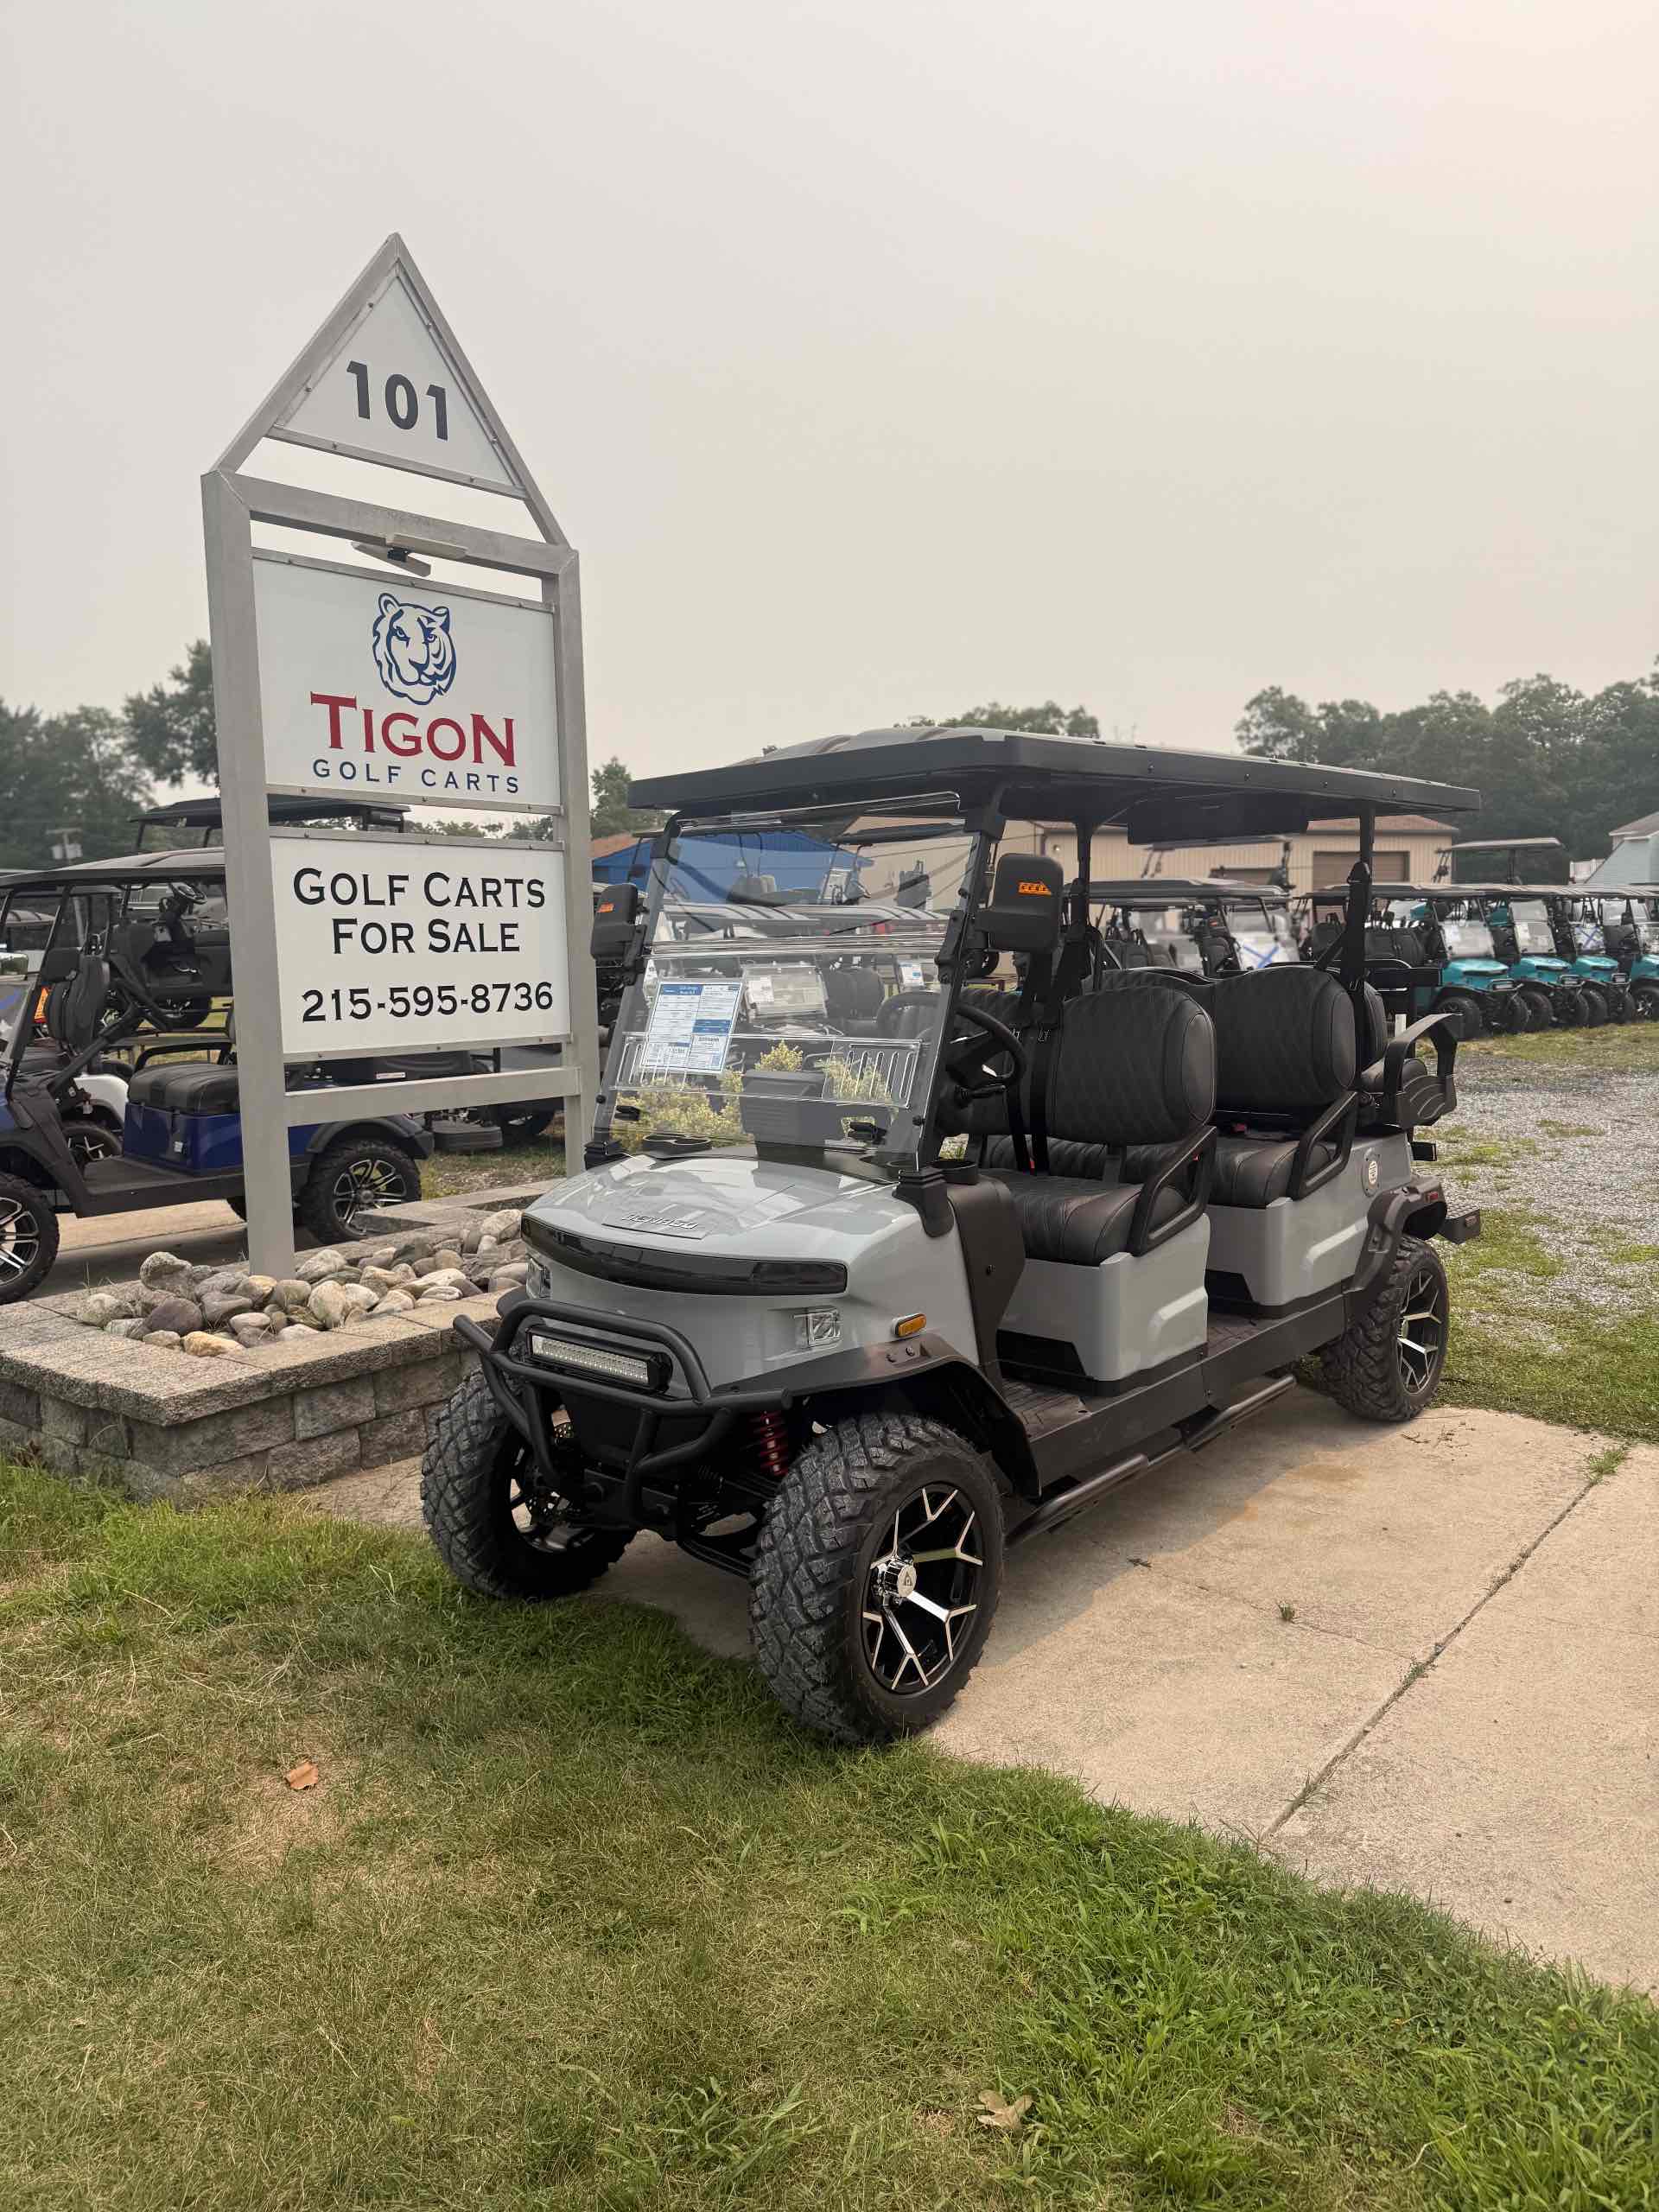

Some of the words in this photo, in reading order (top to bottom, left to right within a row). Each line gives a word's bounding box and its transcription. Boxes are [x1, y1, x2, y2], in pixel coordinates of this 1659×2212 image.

[346, 360, 448, 441] 101
[310, 692, 517, 767] TIGON
[313, 759, 401, 784] GOLF
[421, 768, 518, 794] CARTS
[293, 868, 410, 906] GOLF
[423, 872, 545, 908] CARTS
[332, 918, 416, 955] FOR
[428, 918, 520, 953] SALE
[302, 982, 554, 1023] 215-595-8736
